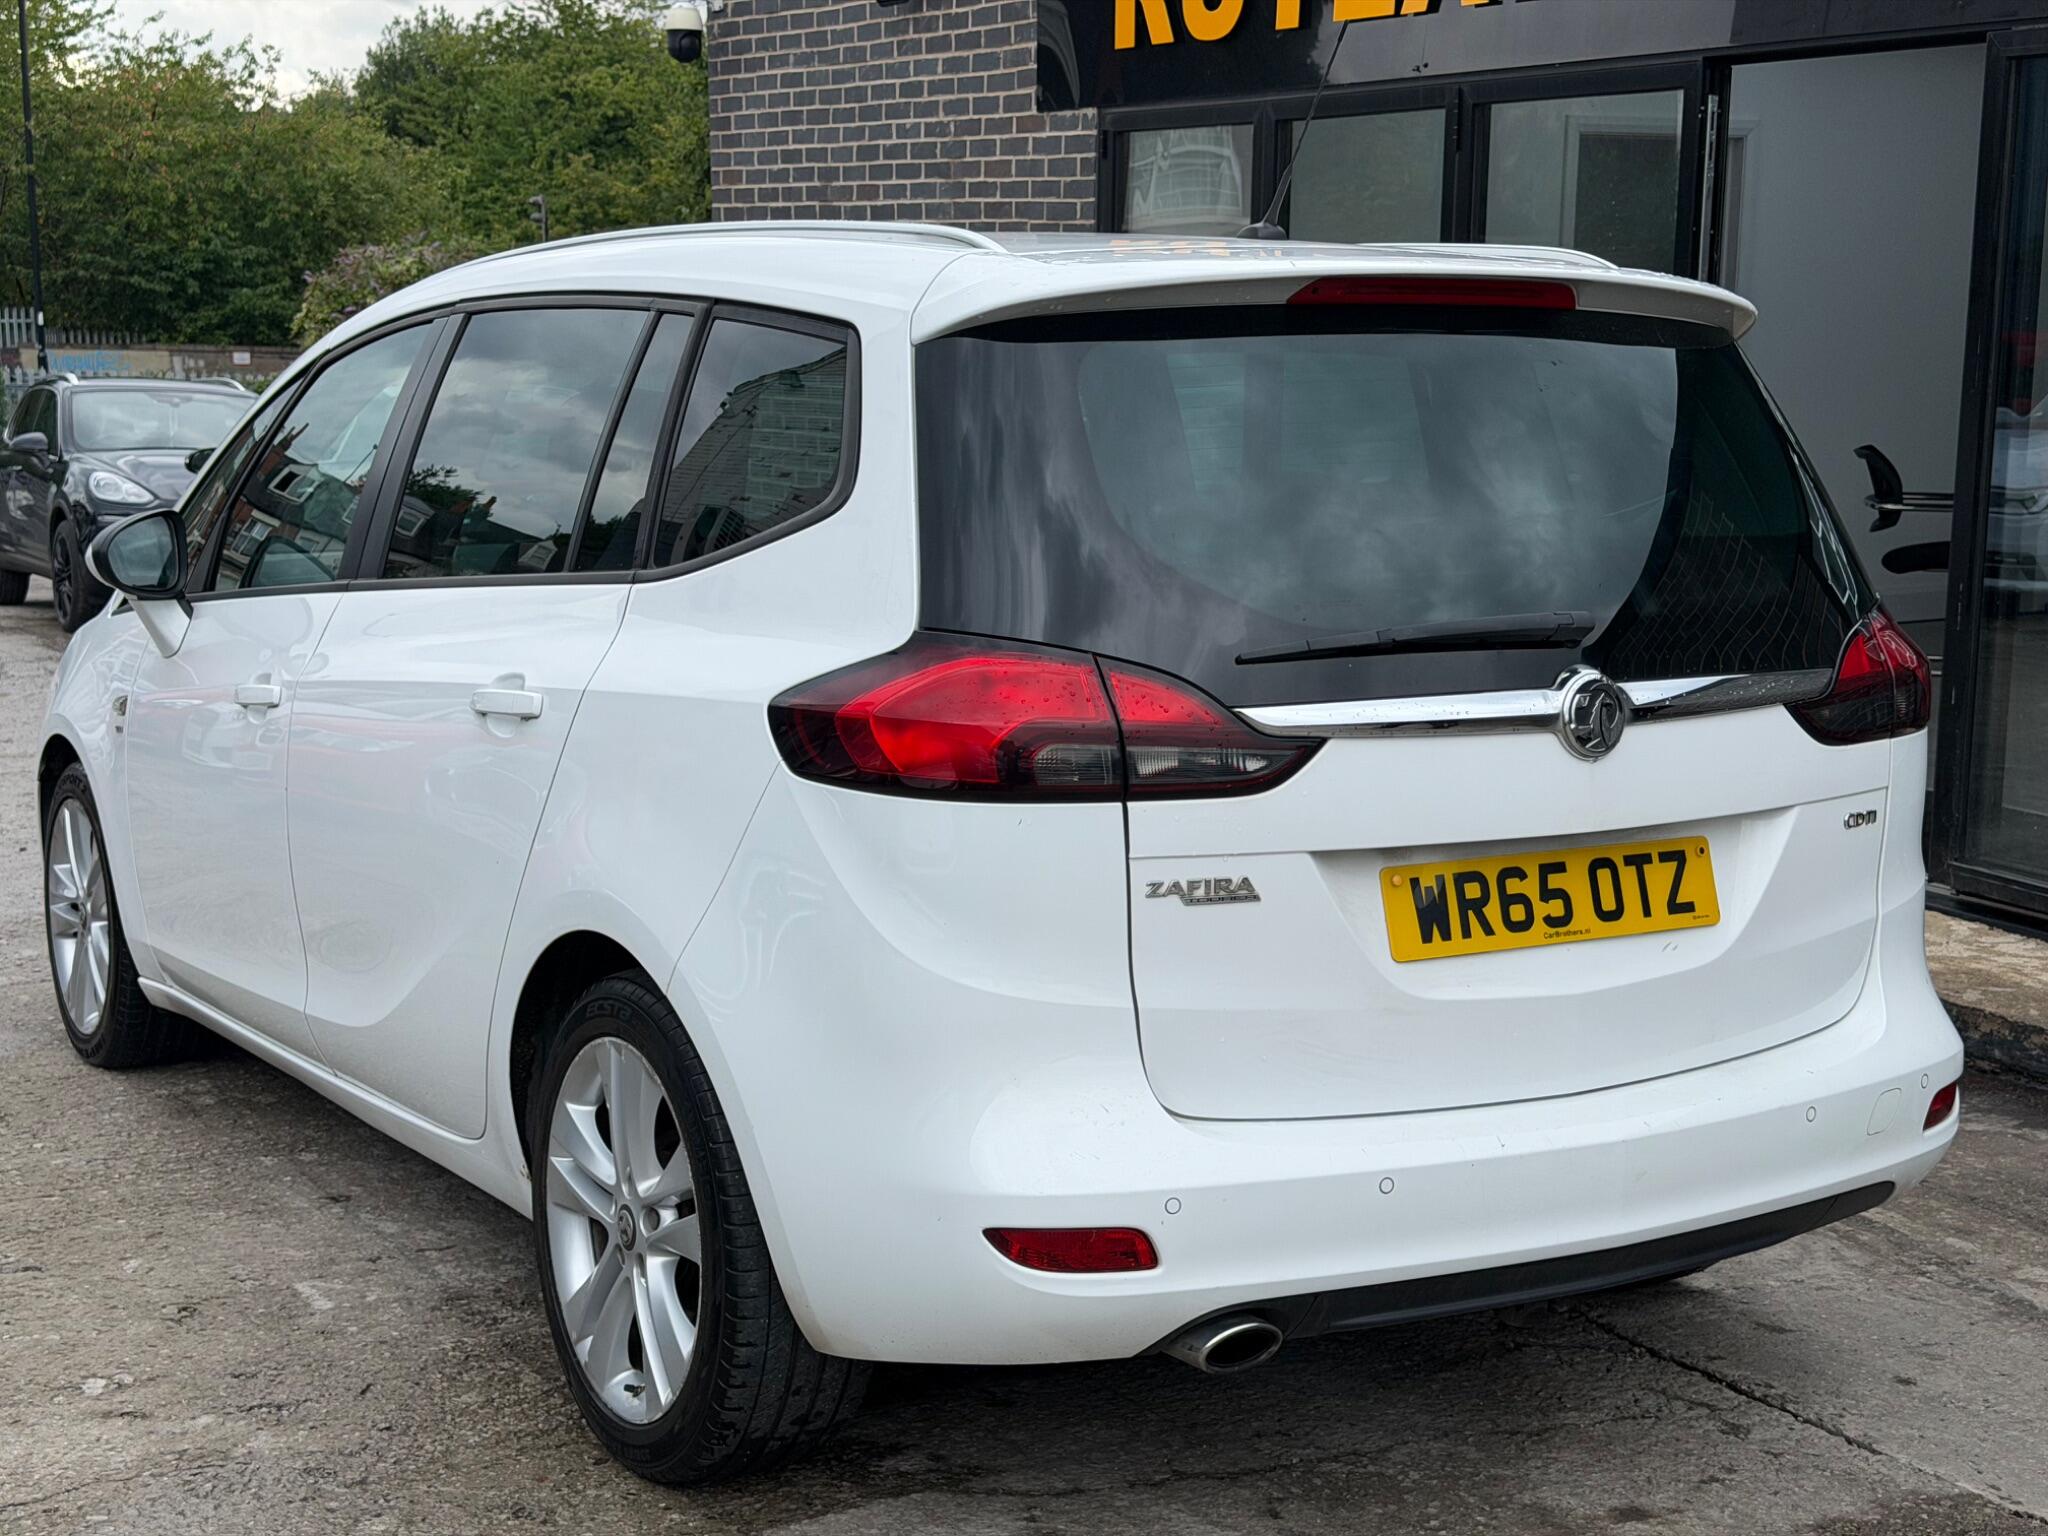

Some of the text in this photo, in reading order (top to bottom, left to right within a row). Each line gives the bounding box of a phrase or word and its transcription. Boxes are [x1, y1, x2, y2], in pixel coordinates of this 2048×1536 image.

[1145, 876, 1257, 899] ZAFIRA
[1409, 849, 1696, 945] WR65 OTZ
